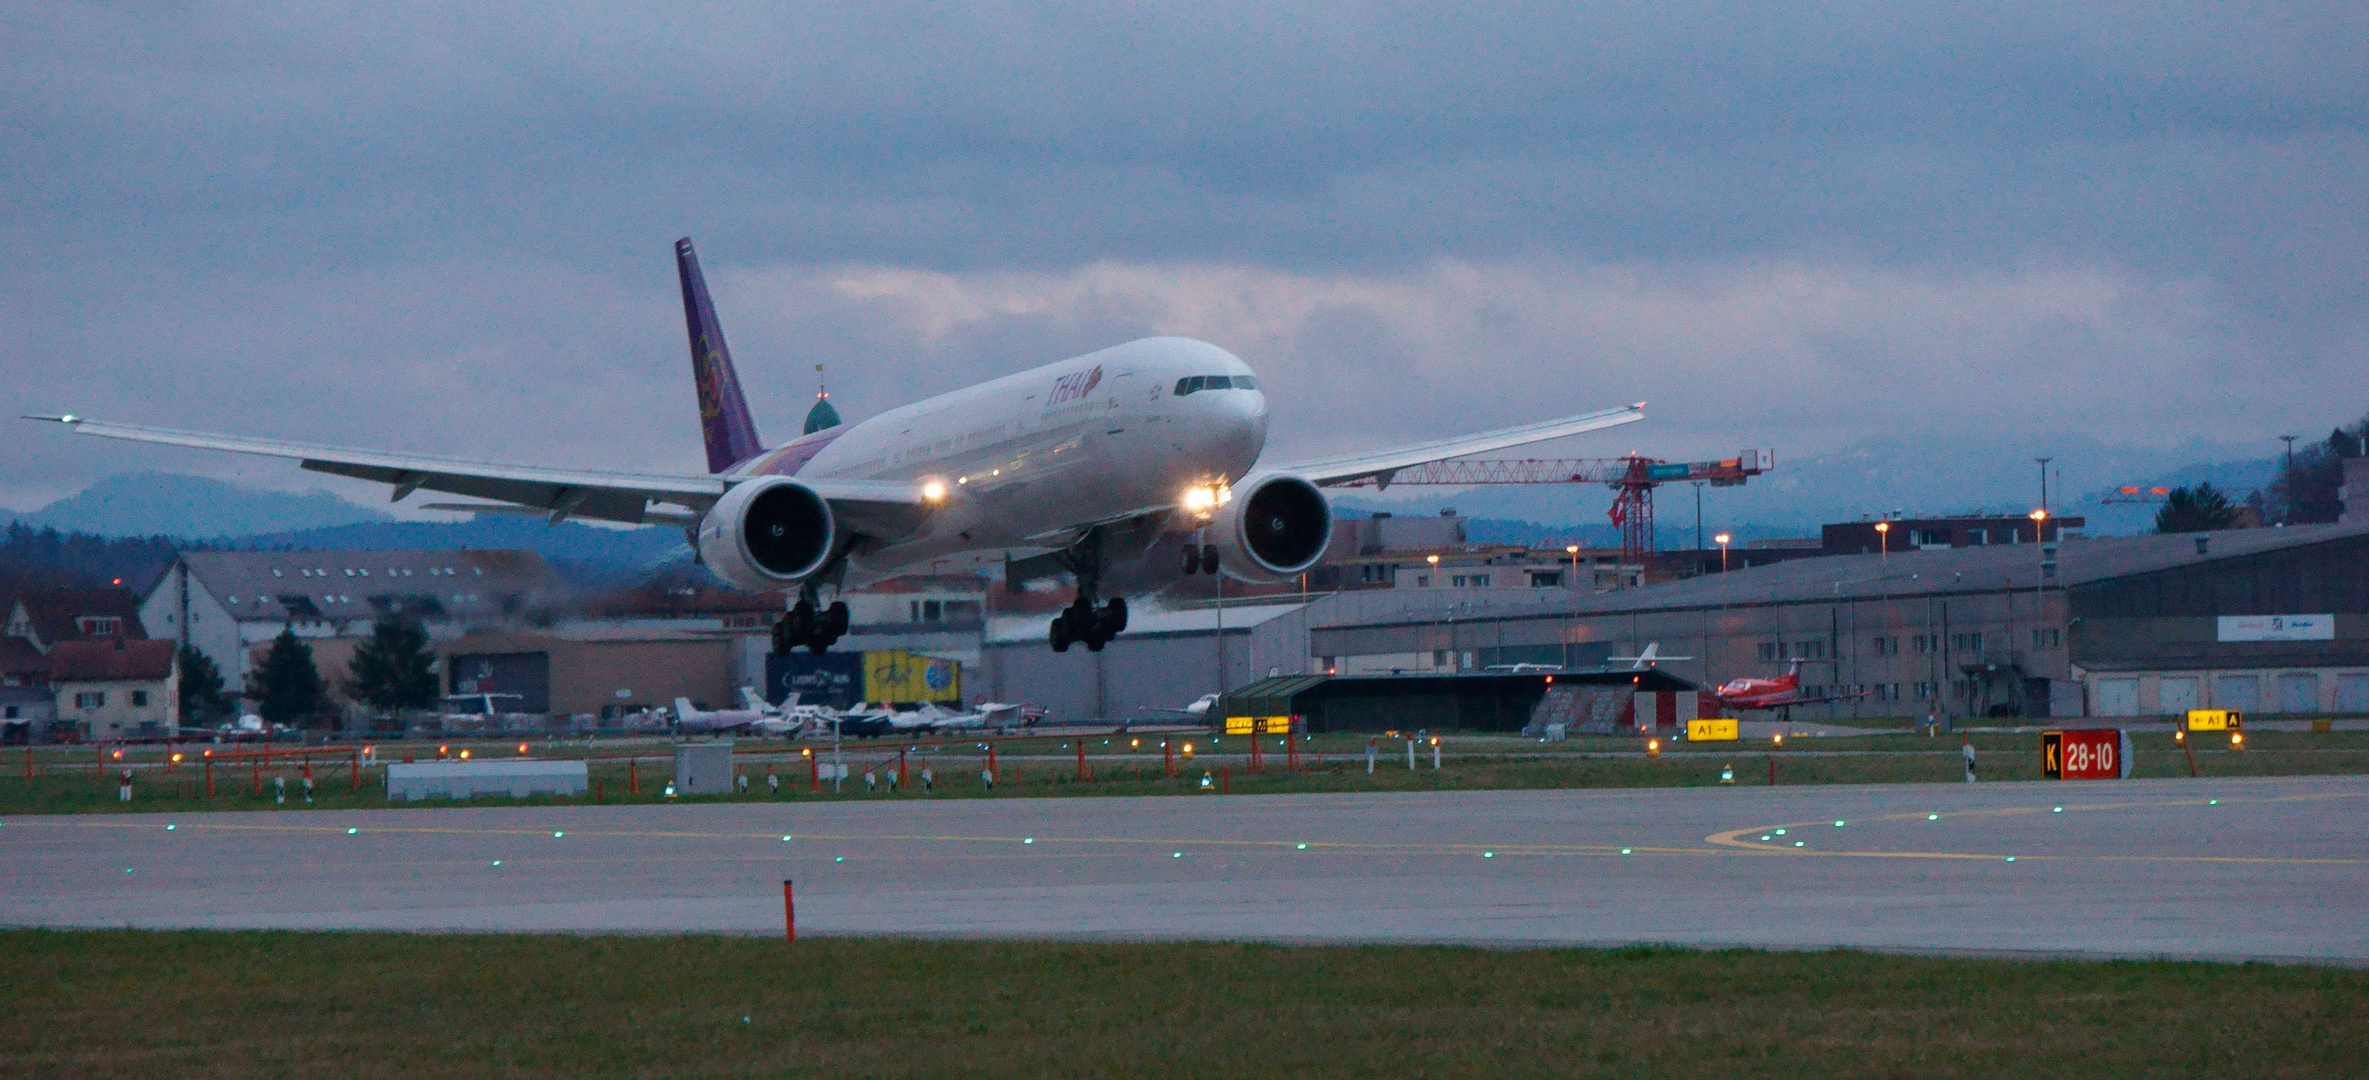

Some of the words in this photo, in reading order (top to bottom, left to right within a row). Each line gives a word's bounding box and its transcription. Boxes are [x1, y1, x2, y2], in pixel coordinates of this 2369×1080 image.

[1046, 369, 1092, 406] THAI
[1698, 724, 1712, 735] A1
[2207, 714, 2220, 726] A1
[2228, 714, 2238, 726] A
[2046, 743, 2057, 772] K
[2067, 742, 2112, 772] 28-10
